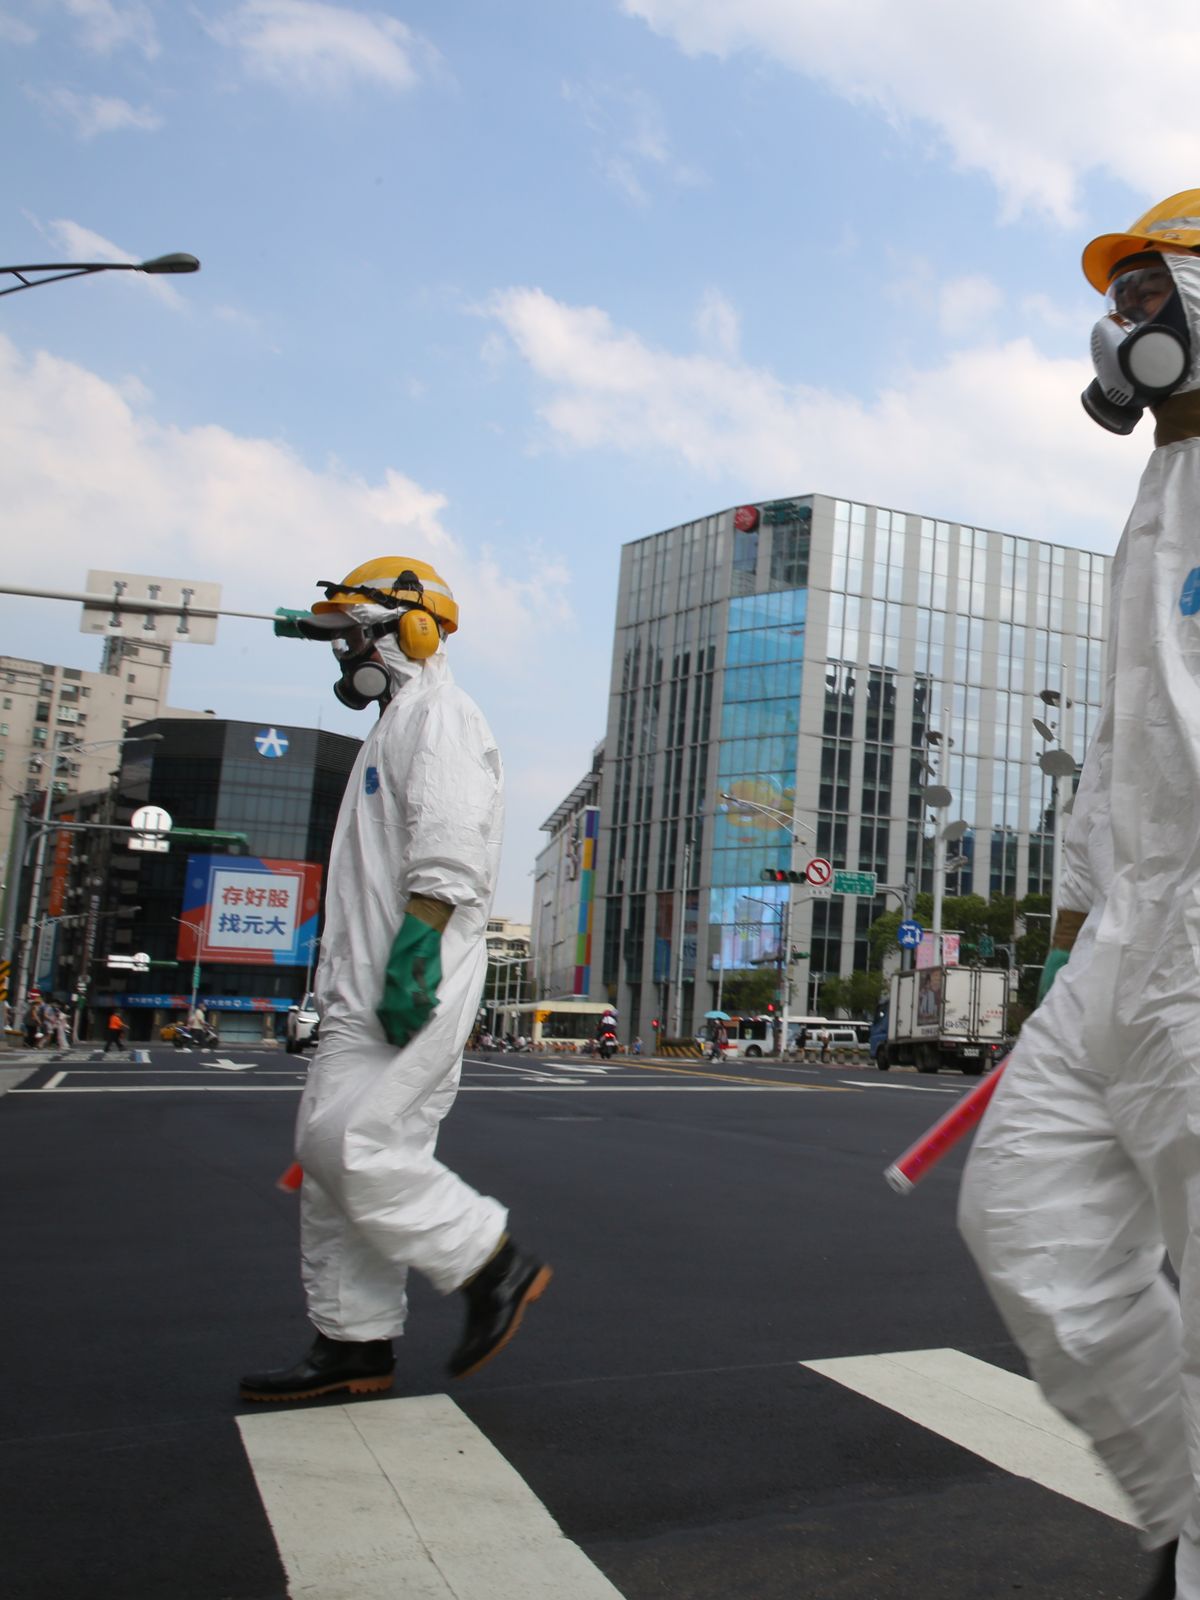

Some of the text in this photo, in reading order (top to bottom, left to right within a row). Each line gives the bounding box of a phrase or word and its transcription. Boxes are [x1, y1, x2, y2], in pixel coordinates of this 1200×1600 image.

[222, 886, 290, 908] 存好股
[218, 913, 287, 936] 找元大
